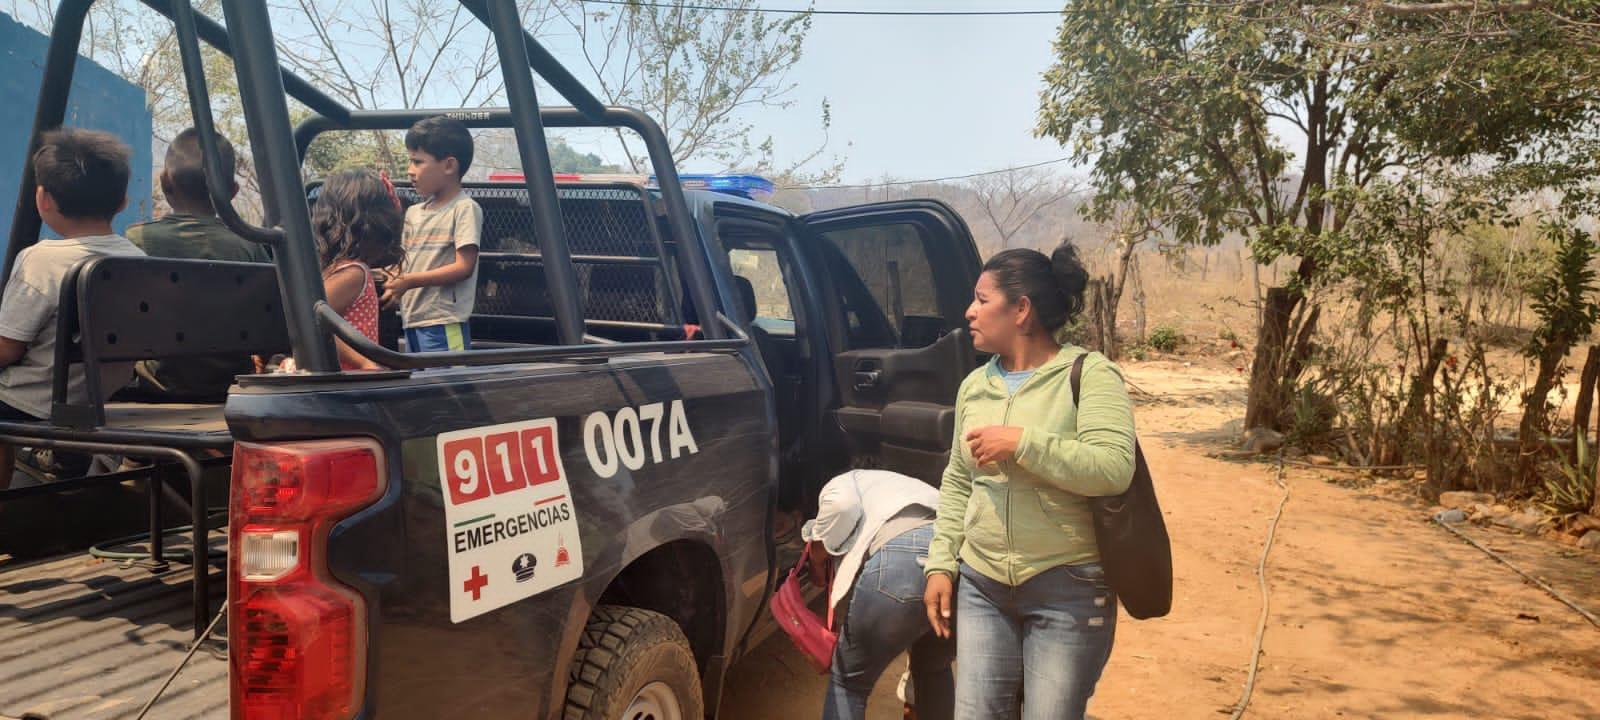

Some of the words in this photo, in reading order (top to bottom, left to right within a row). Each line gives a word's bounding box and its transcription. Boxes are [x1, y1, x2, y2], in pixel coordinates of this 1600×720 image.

[446, 112, 490, 120] THUNDER
[453, 434, 548, 494] 911
[583, 399, 699, 479] 007A
[454, 503, 570, 553] EMERGENCIAS
